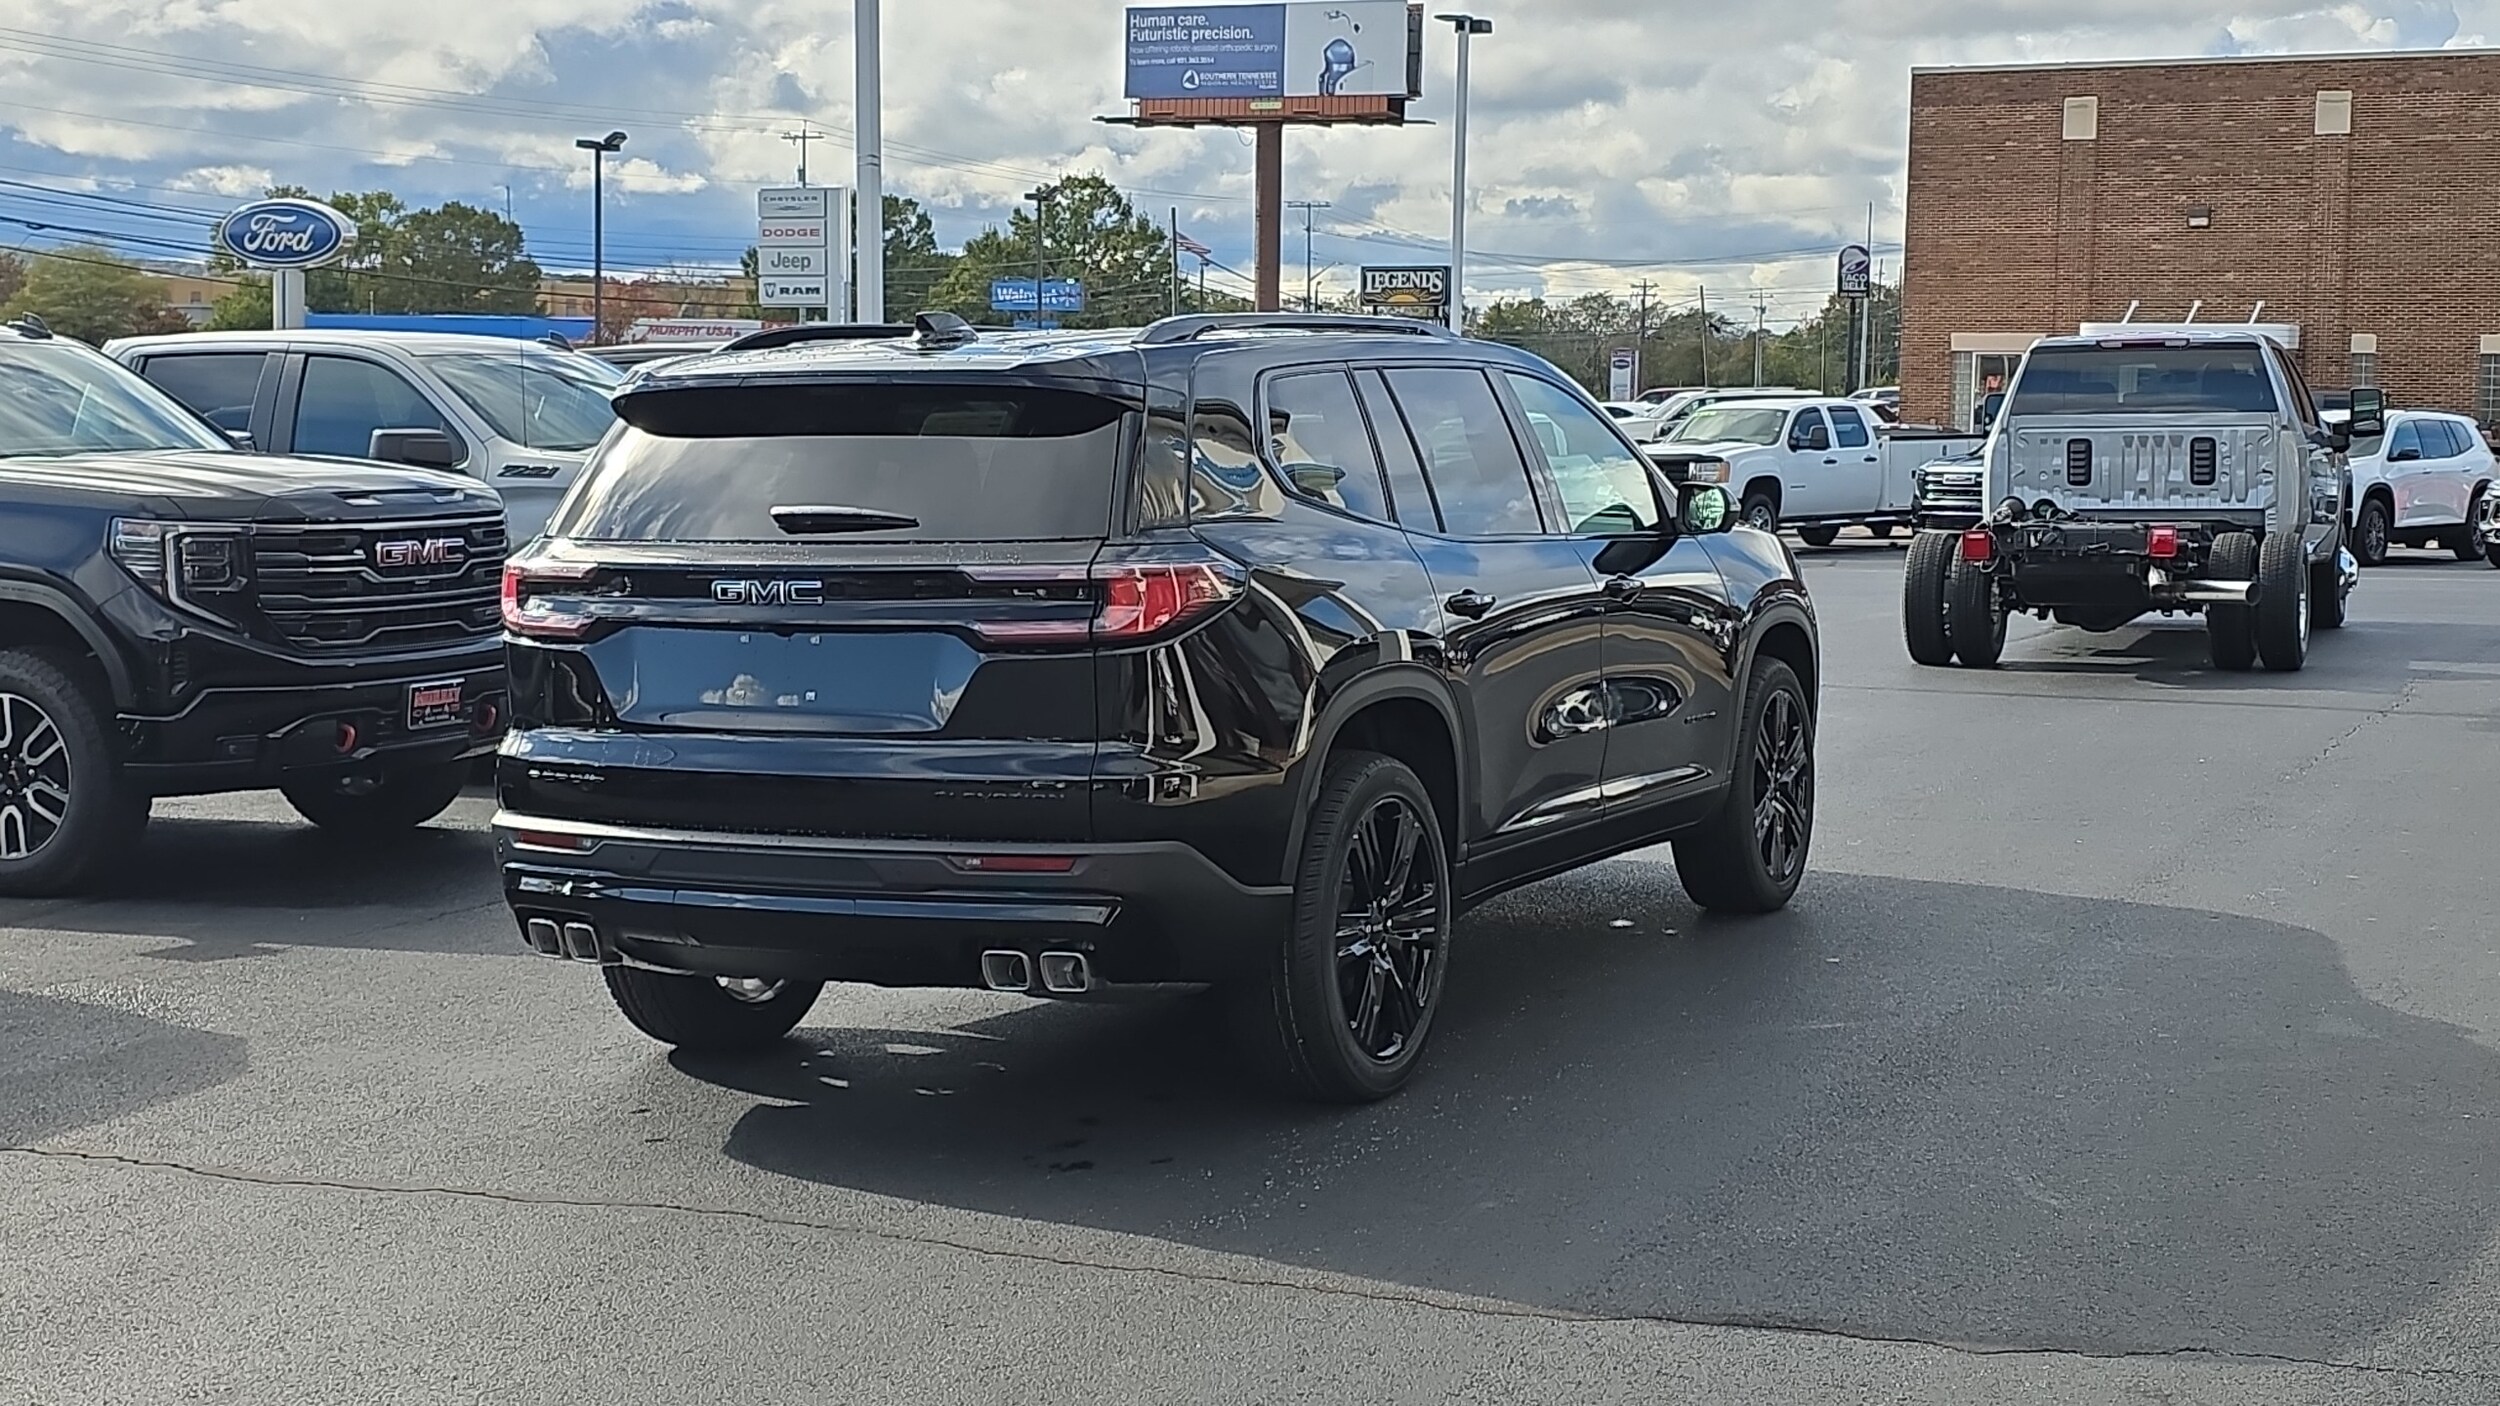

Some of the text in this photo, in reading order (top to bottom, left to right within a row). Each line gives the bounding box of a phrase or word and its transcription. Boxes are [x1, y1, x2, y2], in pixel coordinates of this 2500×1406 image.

[1130, 14, 1209, 28] Human care.
[1130, 25, 1254, 43] Futuristic precision.
[1254, 44, 1278, 53] surgery
[243, 213, 315, 252] Ford
[762, 228, 820, 237] DODGE
[770, 251, 812, 272] Jeep
[1364, 271, 1443, 293] LEGENDS
[1841, 273, 1868, 281] TACO
[779, 286, 821, 295] RAM
[1842, 281, 1868, 291] BELL
[647, 325, 733, 337] MURPHY USA
[375, 538, 465, 567] GMC
[711, 580, 823, 604] GMC
